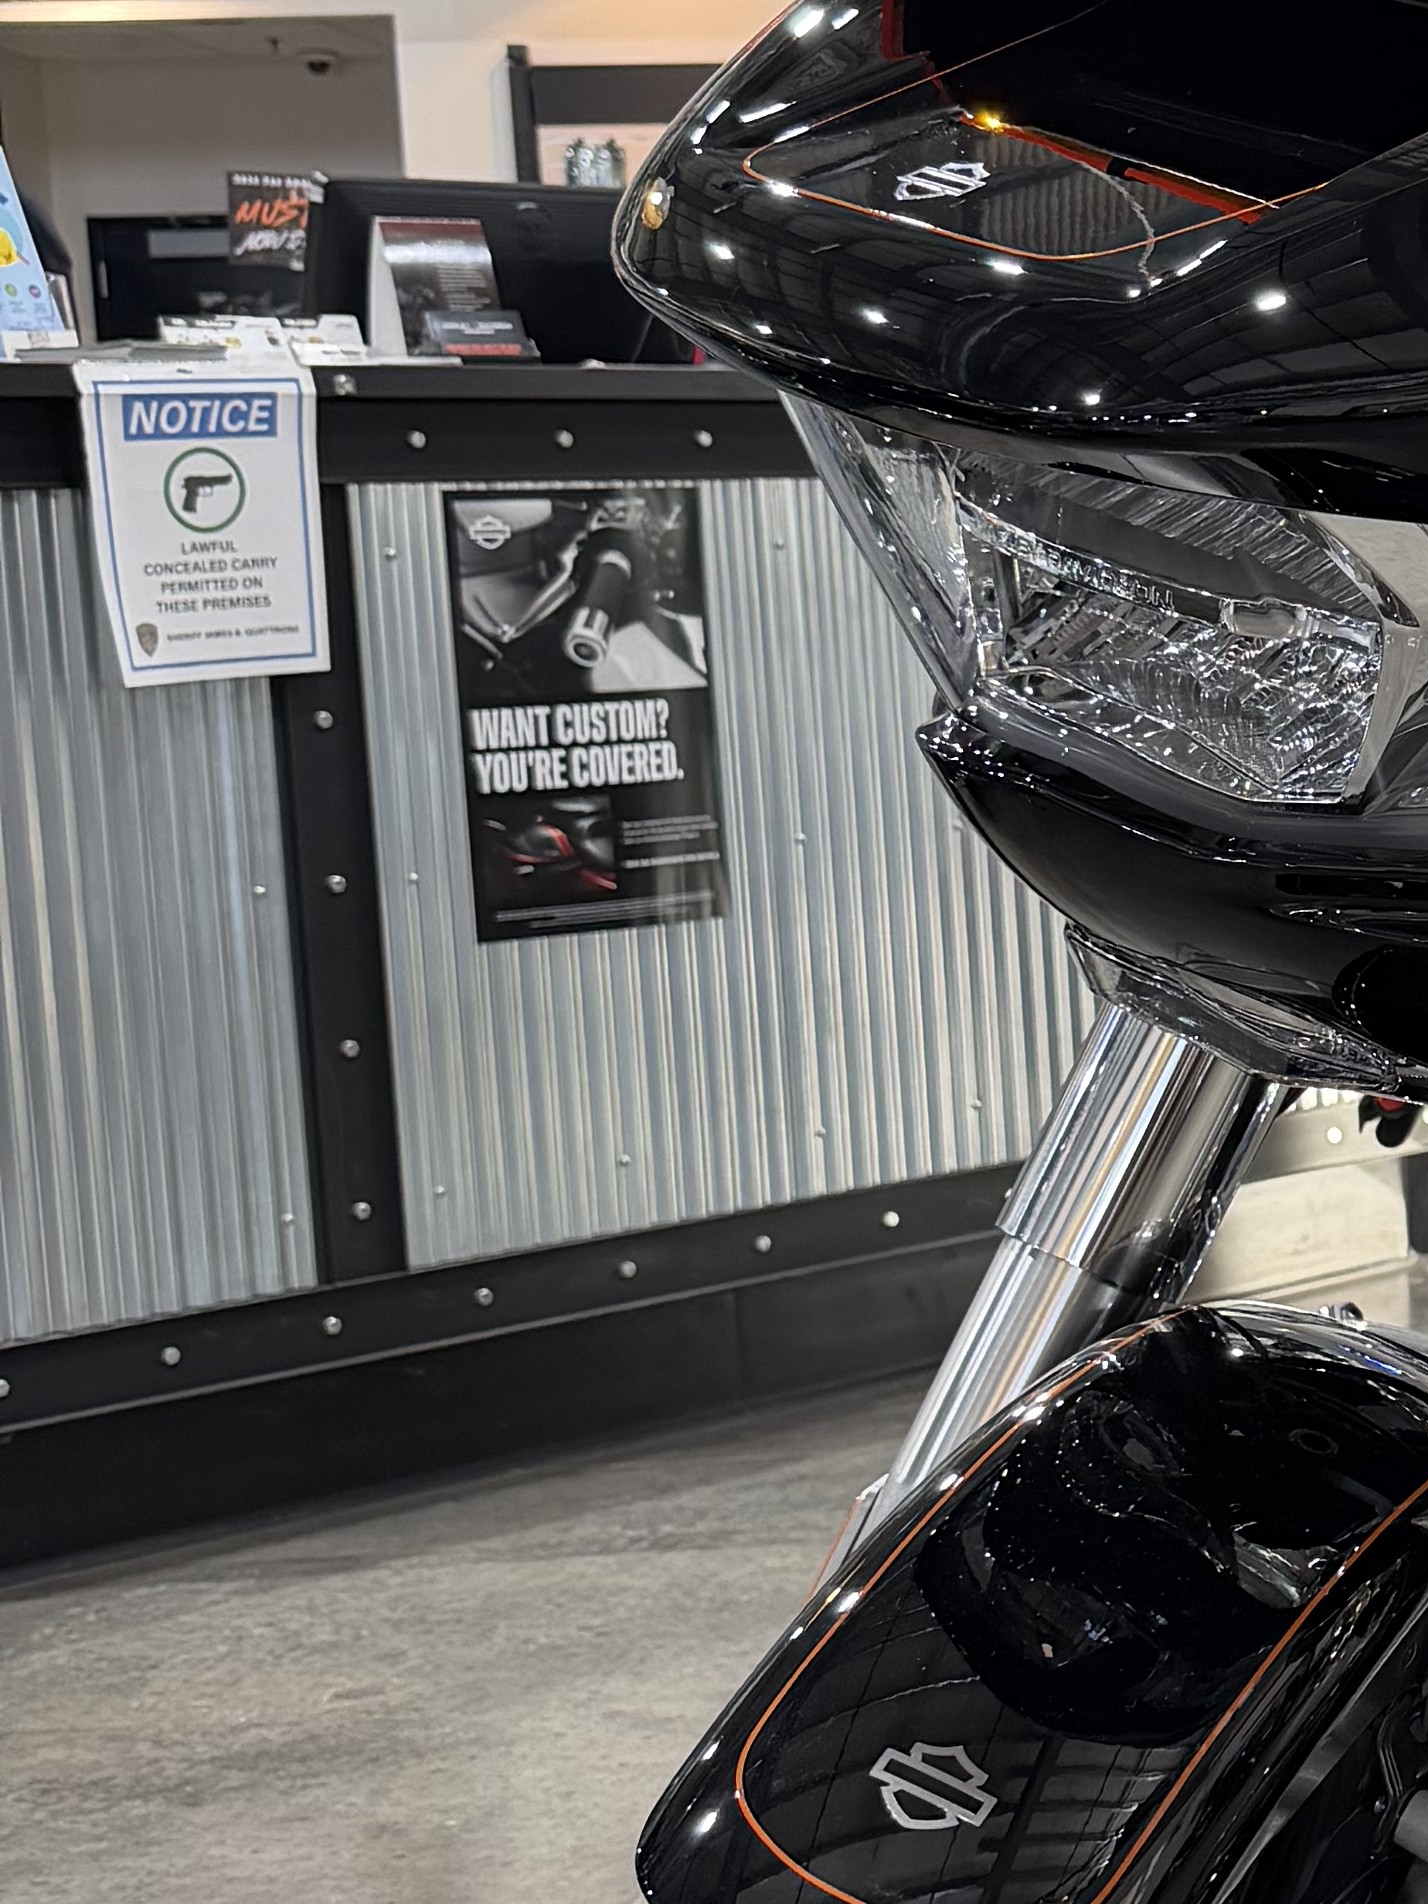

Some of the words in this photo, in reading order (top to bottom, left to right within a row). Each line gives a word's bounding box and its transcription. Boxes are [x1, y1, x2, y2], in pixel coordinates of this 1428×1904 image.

[127, 397, 273, 436] NOTICE
[180, 539, 238, 556] LAWFUL
[143, 560, 228, 577] CONCEALED
[231, 556, 279, 573] CARRY
[160, 578, 239, 595] PERMITTED
[242, 576, 264, 590] ON
[155, 599, 200, 614] THESE
[202, 595, 272, 611] PREMISES
[468, 705, 551, 751] WANT
[554, 698, 670, 746] CUSTOM?
[473, 748, 569, 795] YOU'RE
[570, 740, 685, 788] COVERED.
